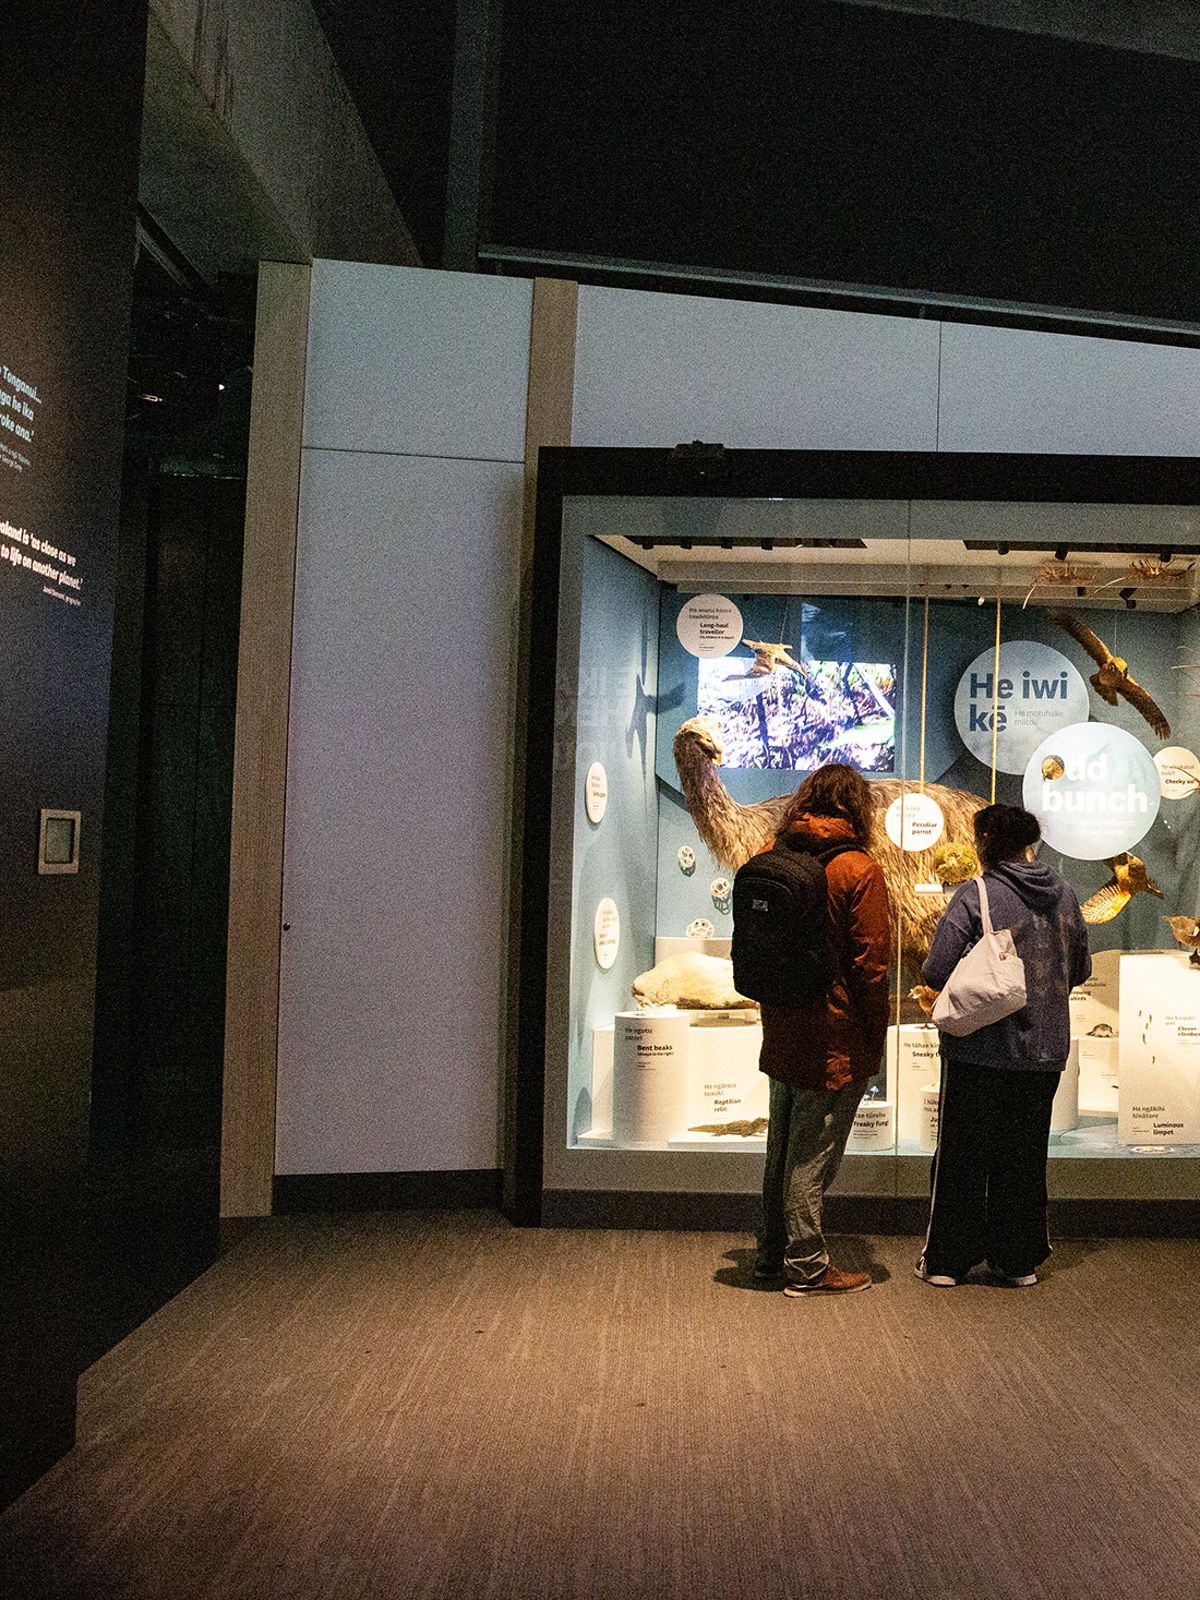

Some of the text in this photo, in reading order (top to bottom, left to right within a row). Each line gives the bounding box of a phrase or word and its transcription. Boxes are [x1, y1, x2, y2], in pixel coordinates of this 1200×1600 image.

[10, 546, 22, 566] life
[22, 556, 32, 569] on
[32, 560, 59, 580] another
[41, 540, 58, 558] close
[970, 671, 1068, 699] He iwi
[969, 704, 1007, 732] kē
[1042, 784, 1148, 813] bunch
